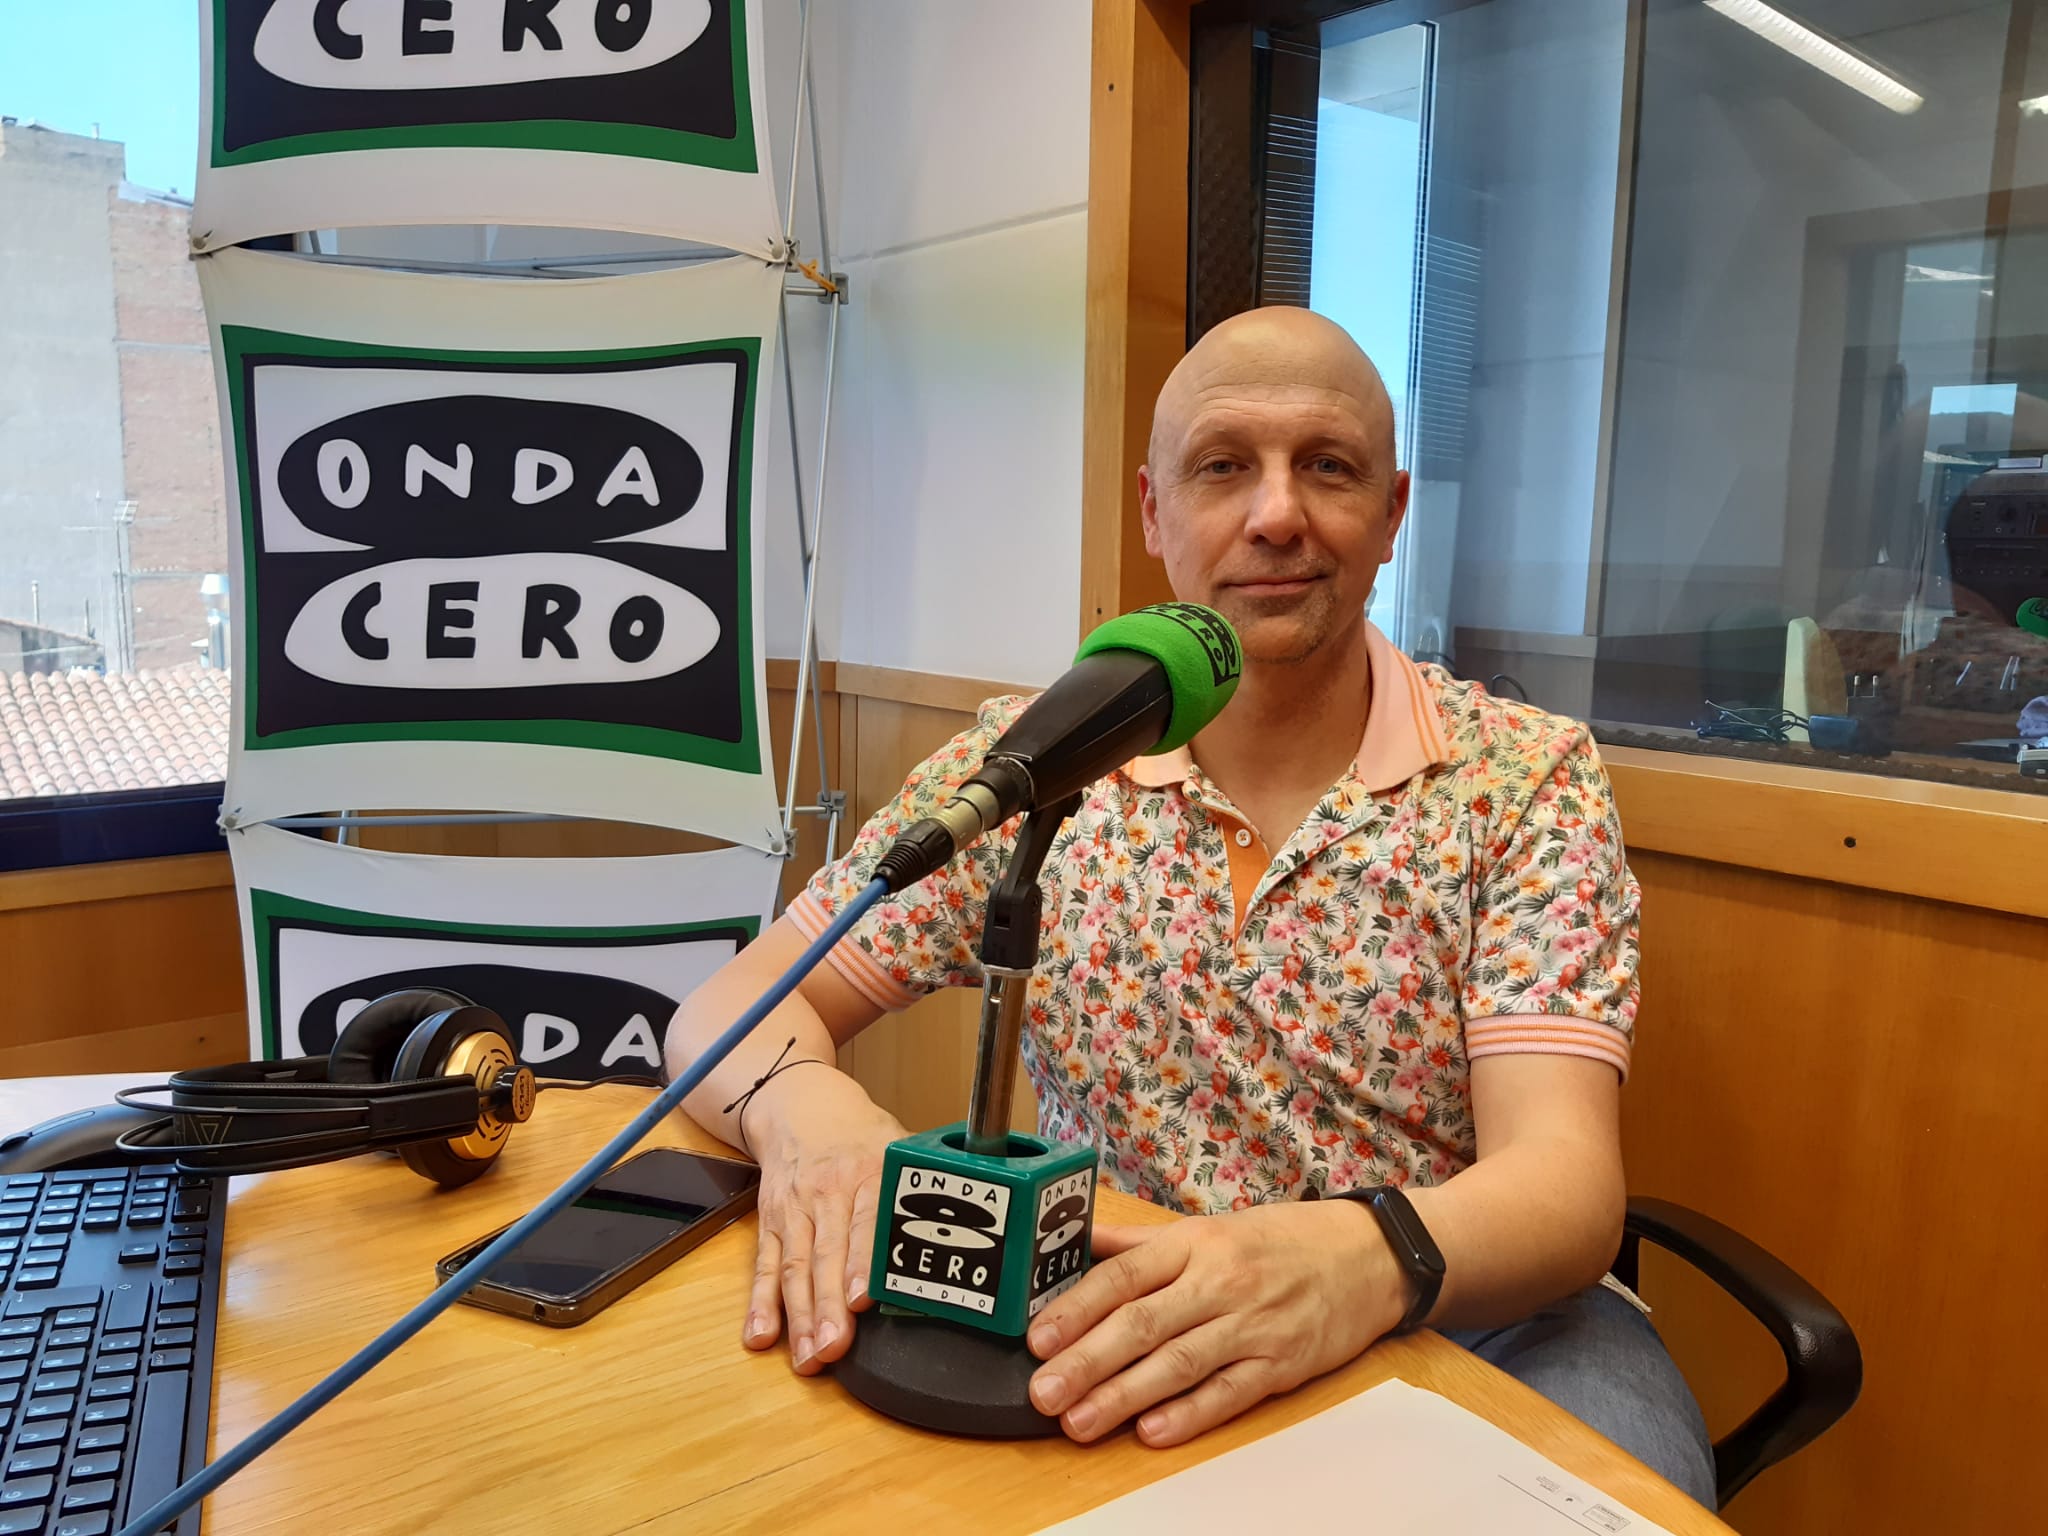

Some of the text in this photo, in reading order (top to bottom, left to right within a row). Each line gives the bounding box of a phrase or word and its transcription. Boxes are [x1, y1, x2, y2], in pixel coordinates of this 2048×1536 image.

[313, 0, 652, 60] CERO
[316, 438, 660, 508] ONDA
[341, 581, 664, 663] CERO
[910, 1171, 998, 1204] ONDA
[1045, 1174, 1089, 1207] ONDA
[892, 1243, 988, 1287] CERO
[1033, 1248, 1080, 1290] CERO
[891, 1279, 986, 1309] RADIO
